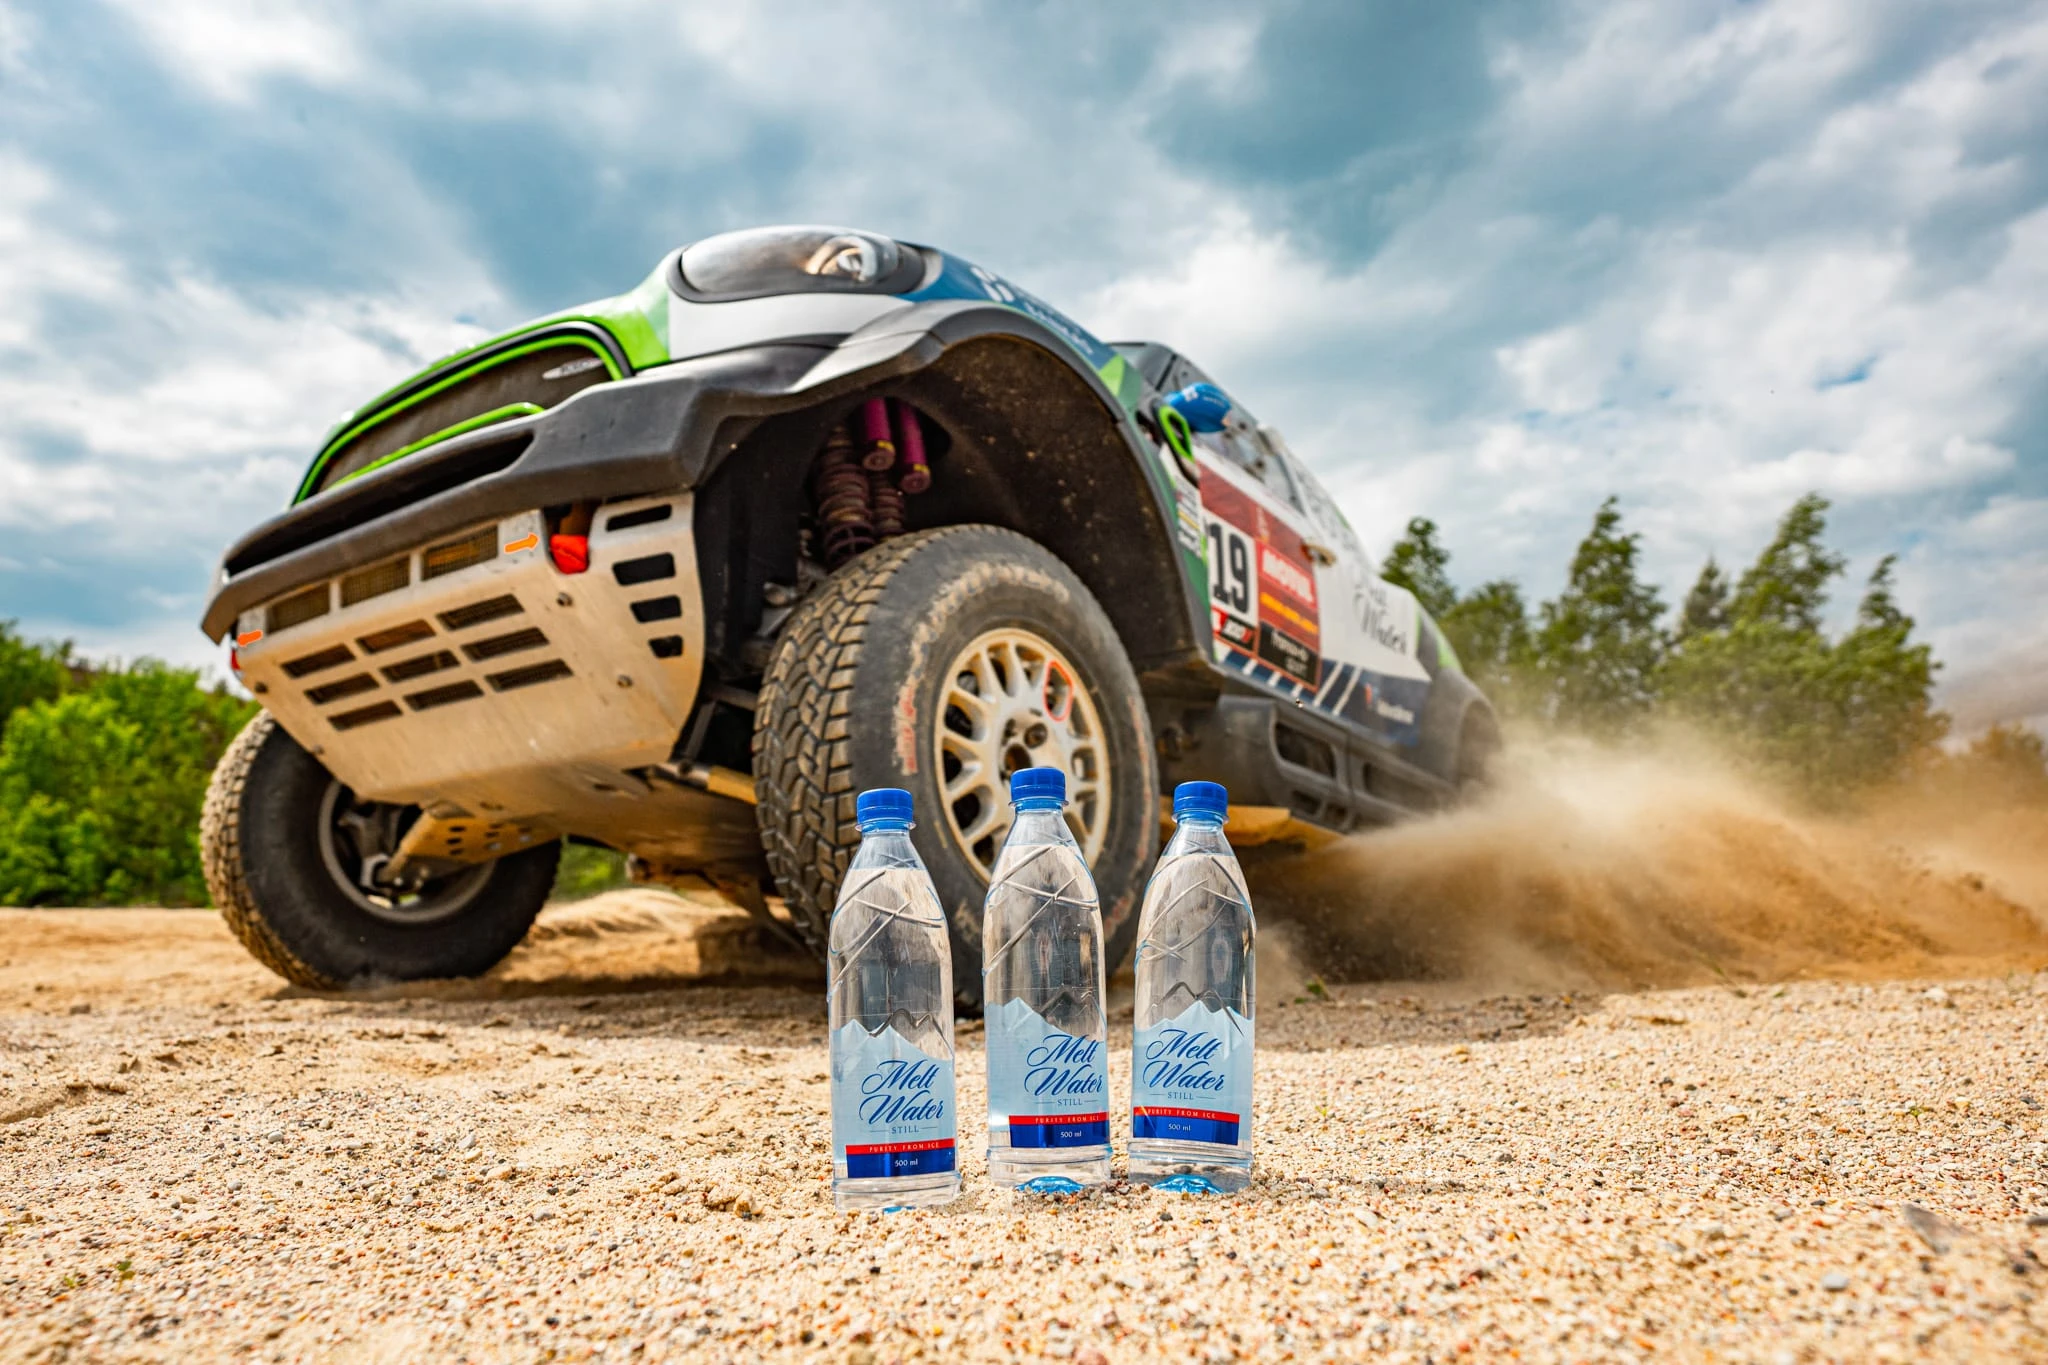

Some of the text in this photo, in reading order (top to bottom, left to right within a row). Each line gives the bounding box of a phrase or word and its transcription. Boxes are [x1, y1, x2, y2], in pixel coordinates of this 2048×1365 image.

[1204, 518, 1250, 613] 19
[1027, 1034, 1100, 1067] Melt
[1146, 1029, 1222, 1060] Melt
[861, 1059, 940, 1095] Melt
[1024, 1064, 1103, 1096] Water
[1142, 1060, 1225, 1091] Water
[859, 1089, 944, 1125] Water
[1057, 1099, 1083, 1107] STILL
[1167, 1091, 1194, 1100] STILL
[891, 1125, 920, 1135] STILL
[902, 1143, 925, 1151] FROM
[927, 1141, 940, 1149] ICE
[894, 1158, 919, 1167] 500 ml
